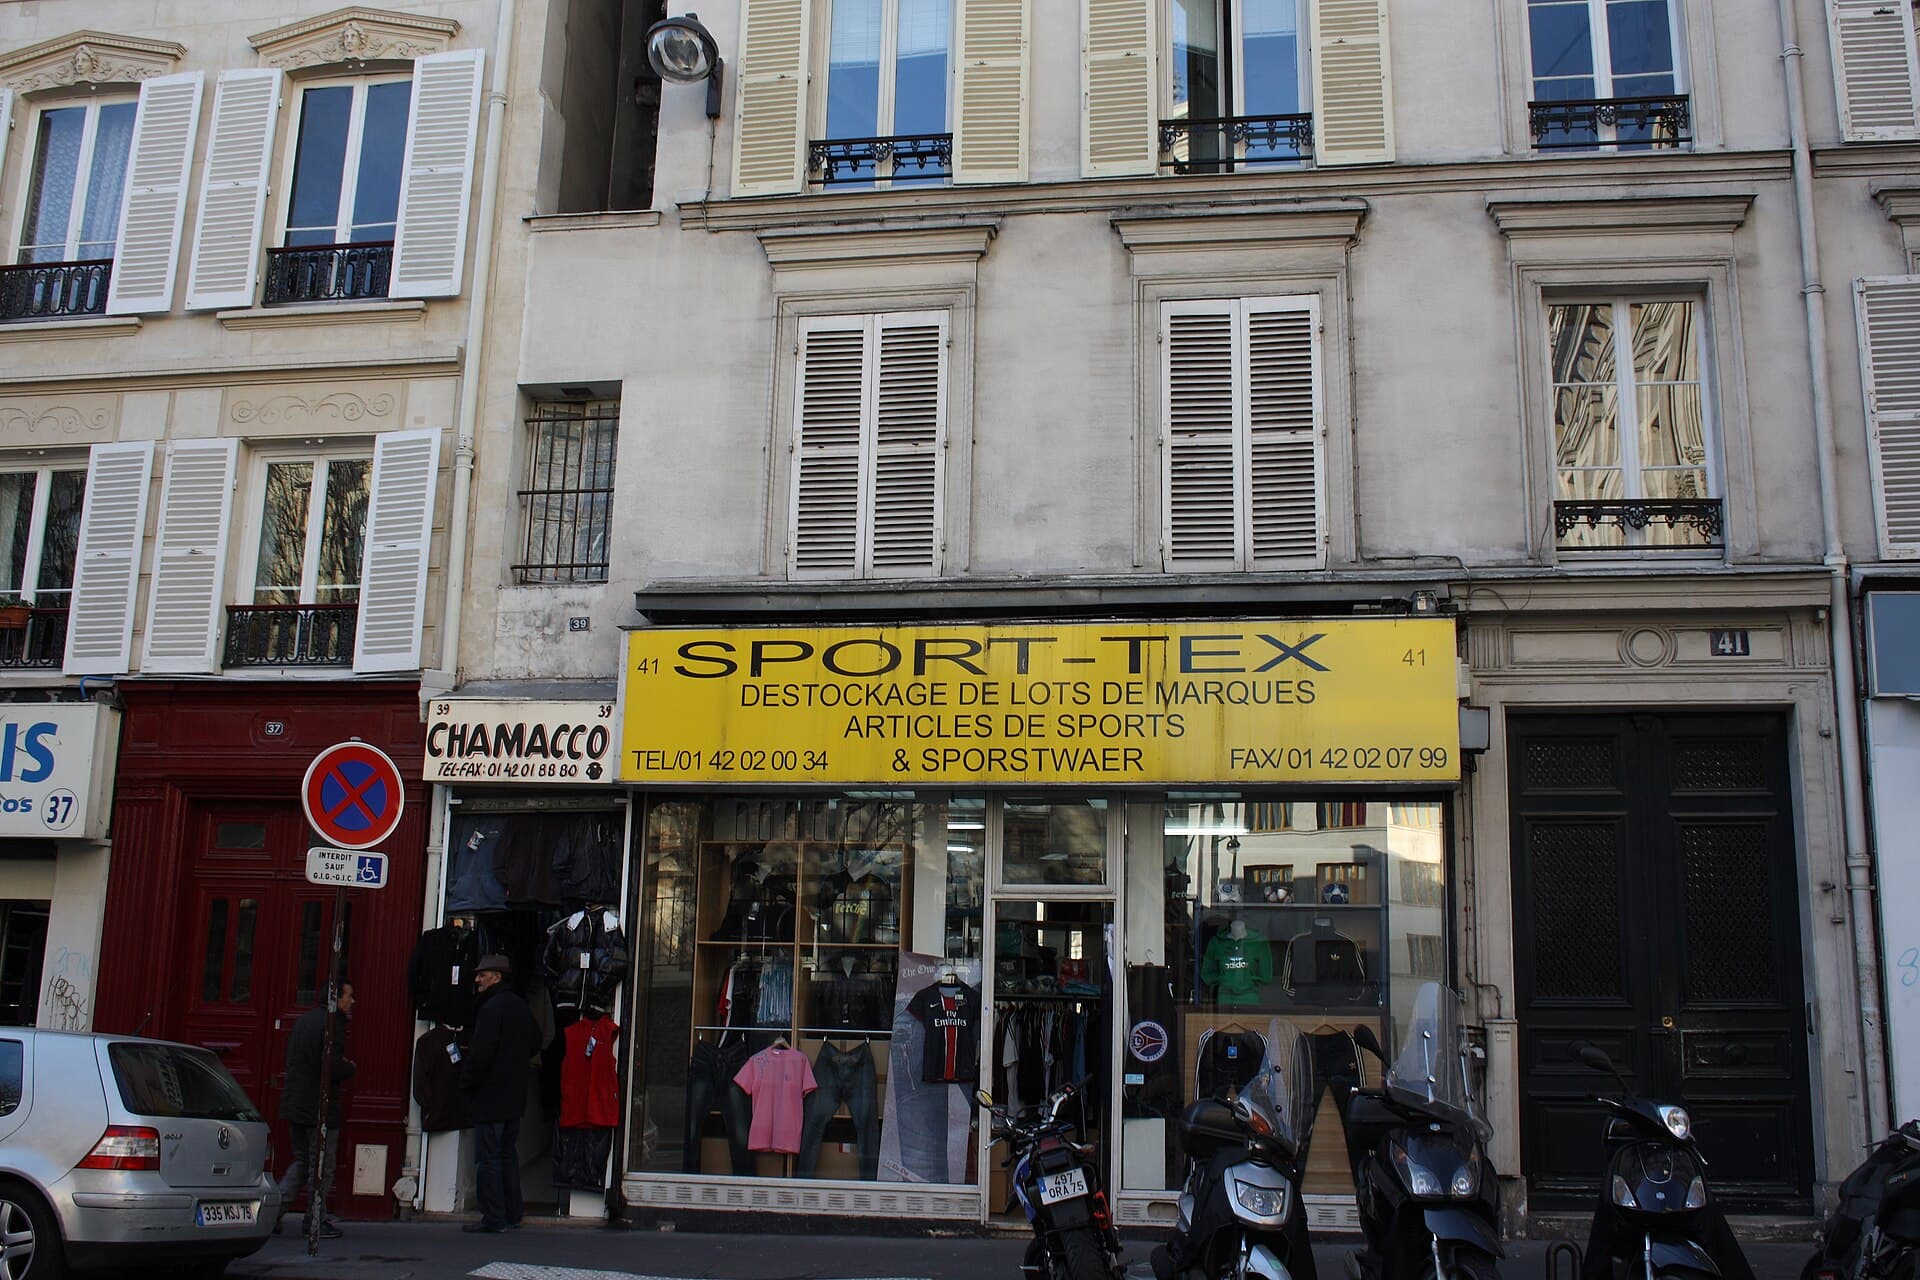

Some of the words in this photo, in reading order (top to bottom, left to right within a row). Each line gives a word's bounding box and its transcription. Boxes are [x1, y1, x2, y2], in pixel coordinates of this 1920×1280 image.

[572, 619, 587, 629] 39
[1718, 631, 1743, 654] 41
[1402, 648, 1427, 666] 41
[637, 658, 659, 675] 41
[741, 683, 948, 707] DESTOCKAGE
[959, 682, 1000, 705] DE
[1010, 681, 1091, 706] LOTS
[1102, 681, 1144, 705] DE
[1155, 680, 1316, 706] MARQUES
[436, 704, 450, 716] 39
[598, 704, 612, 719] 39
[267, 724, 281, 734] 37
[844, 714, 993, 739] ARTICLES
[1004, 714, 1046, 738] DE
[1056, 713, 1185, 738] SPORTS
[427, 721, 610, 761] CHAMACCO
[708, 750, 735, 771] 42
[740, 750, 766, 771] 02
[771, 750, 798, 771] 00
[802, 750, 829, 771] 34
[892, 748, 911, 772] &
[921, 747, 1144, 772] SPORSTWAER
[1320, 747, 1348, 769] 42
[1354, 747, 1381, 769] 02
[1387, 747, 1414, 769] 07
[1420, 747, 1448, 769] 99
[0, 799, 33, 813] os
[47, 796, 73, 824] 37
[318, 851, 353, 861] INTERDIT
[324, 862, 345, 871] SAUF
[1054, 1172, 1073, 1186] 497
[1070, 1181, 1084, 1193] 75
[204, 1205, 223, 1221] 335
[240, 1204, 253, 1221] 75
